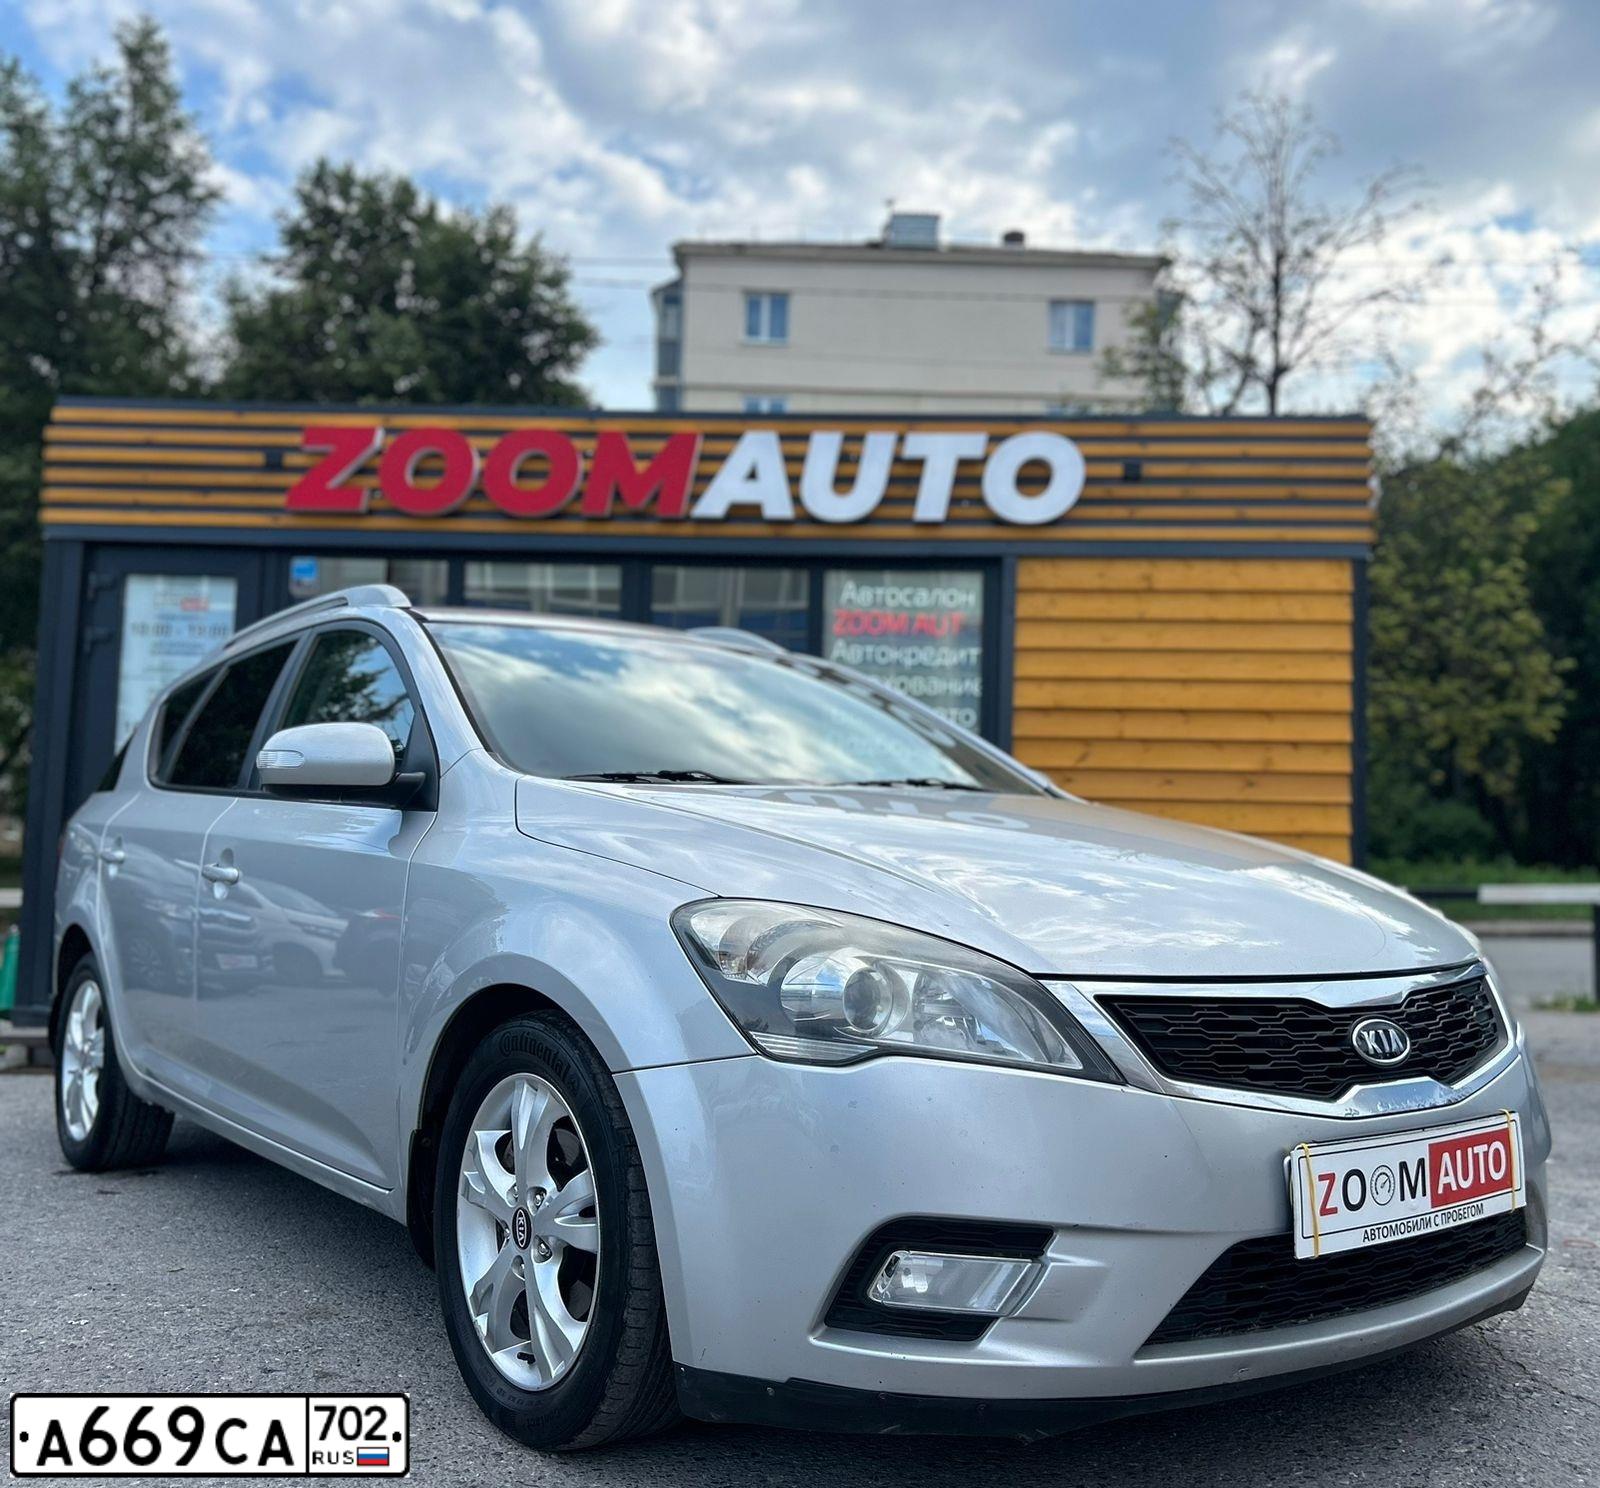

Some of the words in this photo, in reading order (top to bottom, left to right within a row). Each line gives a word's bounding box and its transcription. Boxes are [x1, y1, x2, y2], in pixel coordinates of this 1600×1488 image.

[839, 580, 976, 608] Автосалон
[830, 638, 981, 669] Автокредит
[499, 1031, 571, 1083] Continental
[1360, 1028, 1404, 1055] KIA
[1438, 1141, 1507, 1195] AUTO
[1362, 1215, 1432, 1243] АВТОМОБИЛИ
[1433, 1215, 1440, 1227] С
[1440, 1203, 1484, 1226] ПРОБЕГОМ
